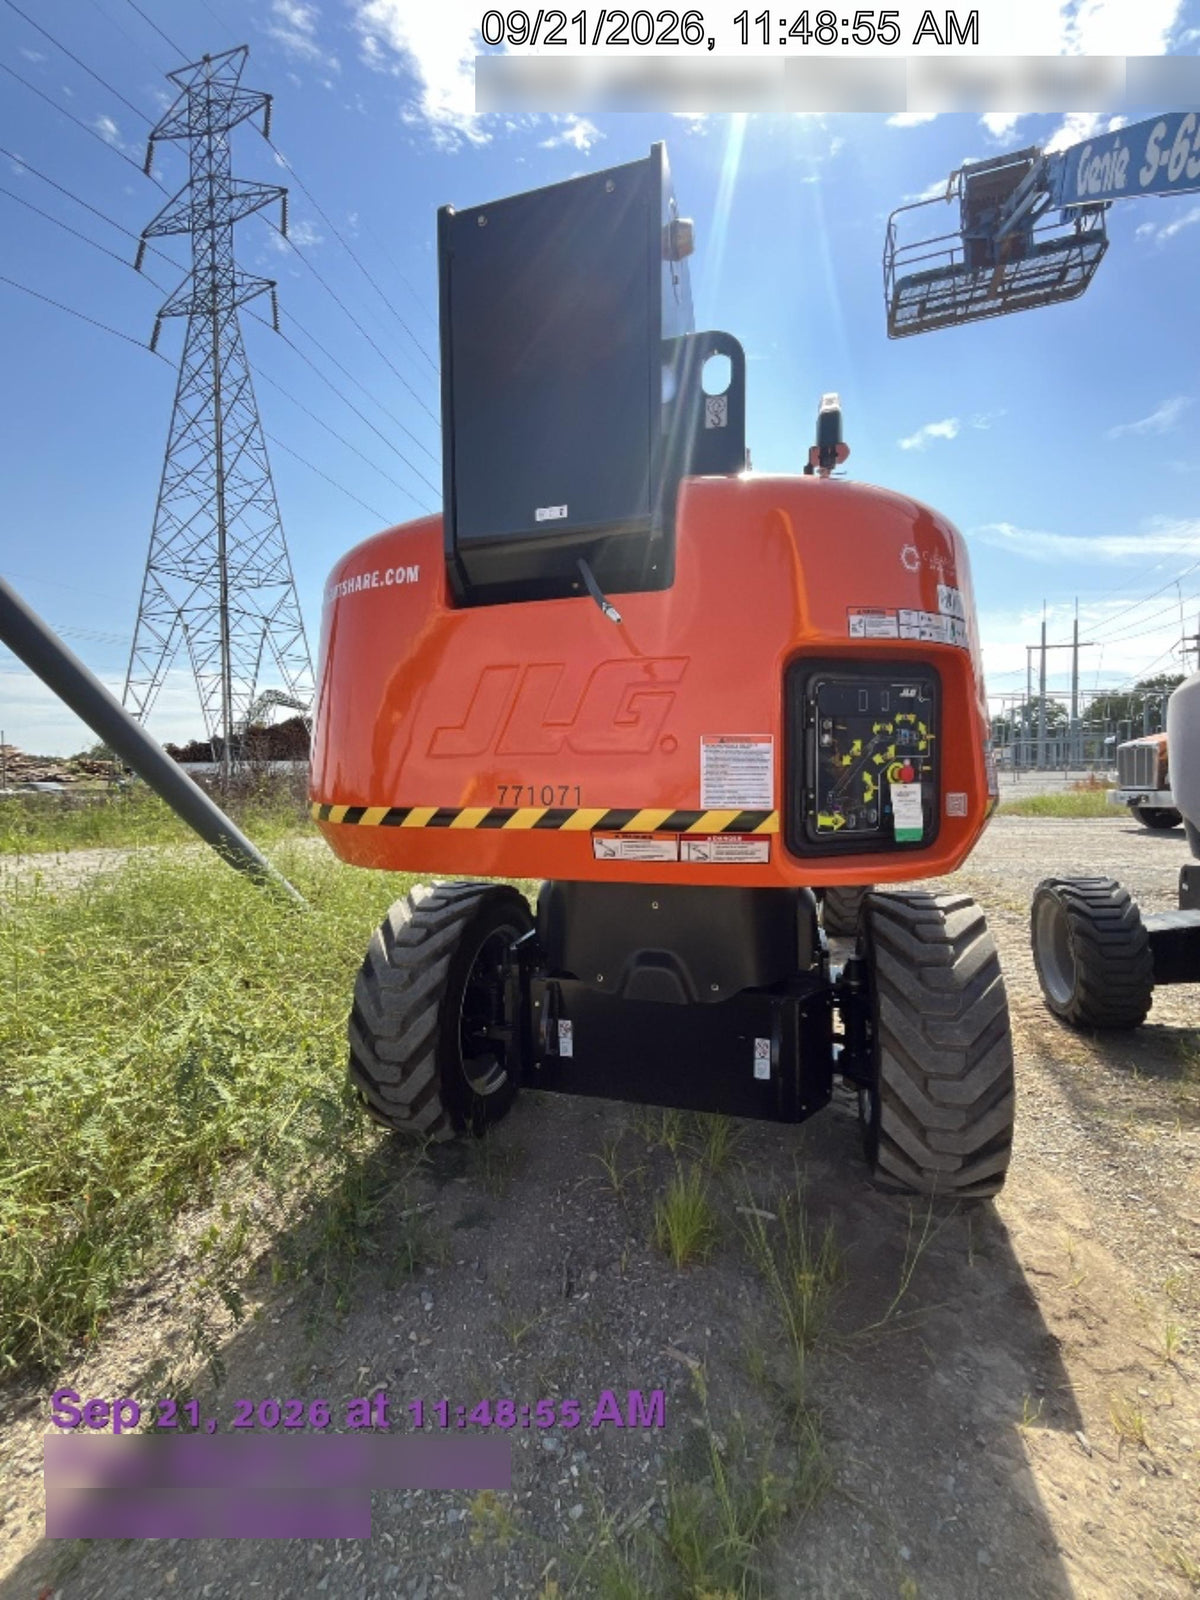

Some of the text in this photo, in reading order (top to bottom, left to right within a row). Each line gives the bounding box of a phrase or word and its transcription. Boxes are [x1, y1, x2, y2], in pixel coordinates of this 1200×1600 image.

[1077, 136, 1130, 197] Genie
[329, 565, 419, 601] TSHARE.COM
[497, 785, 581, 806] 771071
